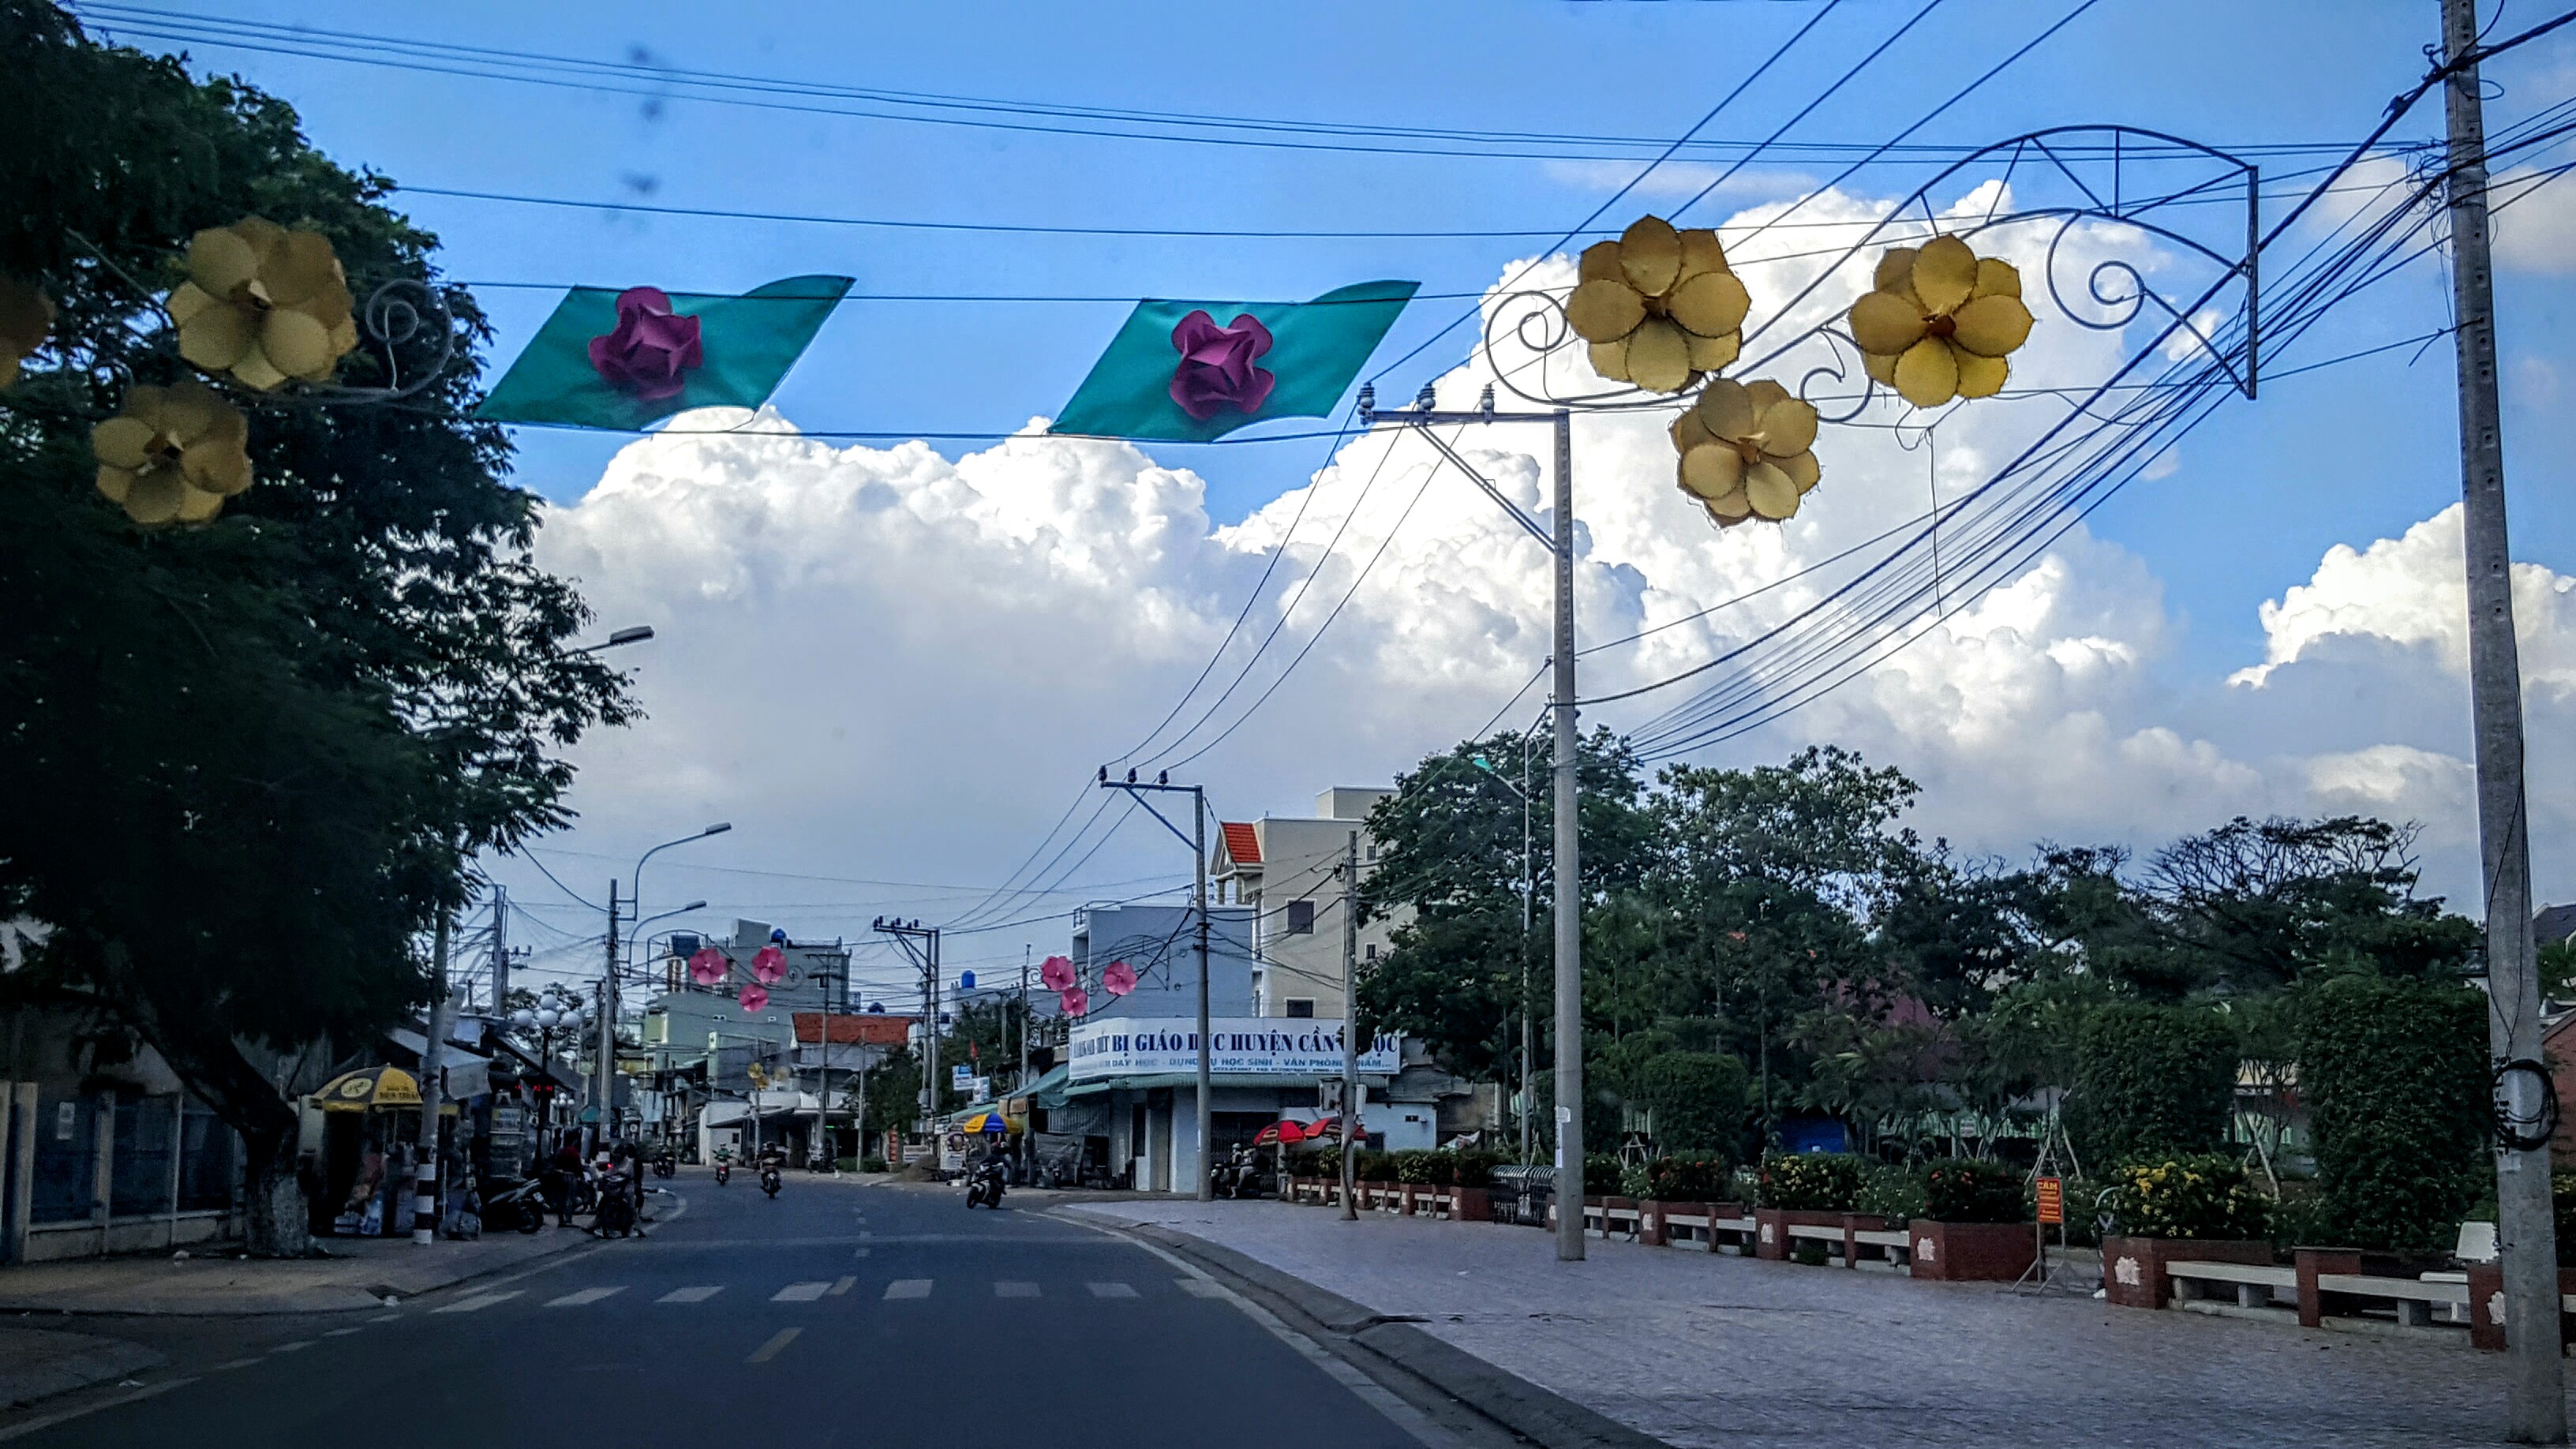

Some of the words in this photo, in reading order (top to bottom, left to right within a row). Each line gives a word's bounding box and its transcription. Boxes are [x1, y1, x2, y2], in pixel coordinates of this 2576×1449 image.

[1112, 1034, 1129, 1057] BỊ
[1135, 1028, 1182, 1050] GIÁO
[1187, 1033, 1225, 1051] DC
[1230, 1029, 1293, 1056] HUYỆN
[1298, 1025, 1335, 1051] CẦN
[1248, 1058, 1272, 1066] SINH
